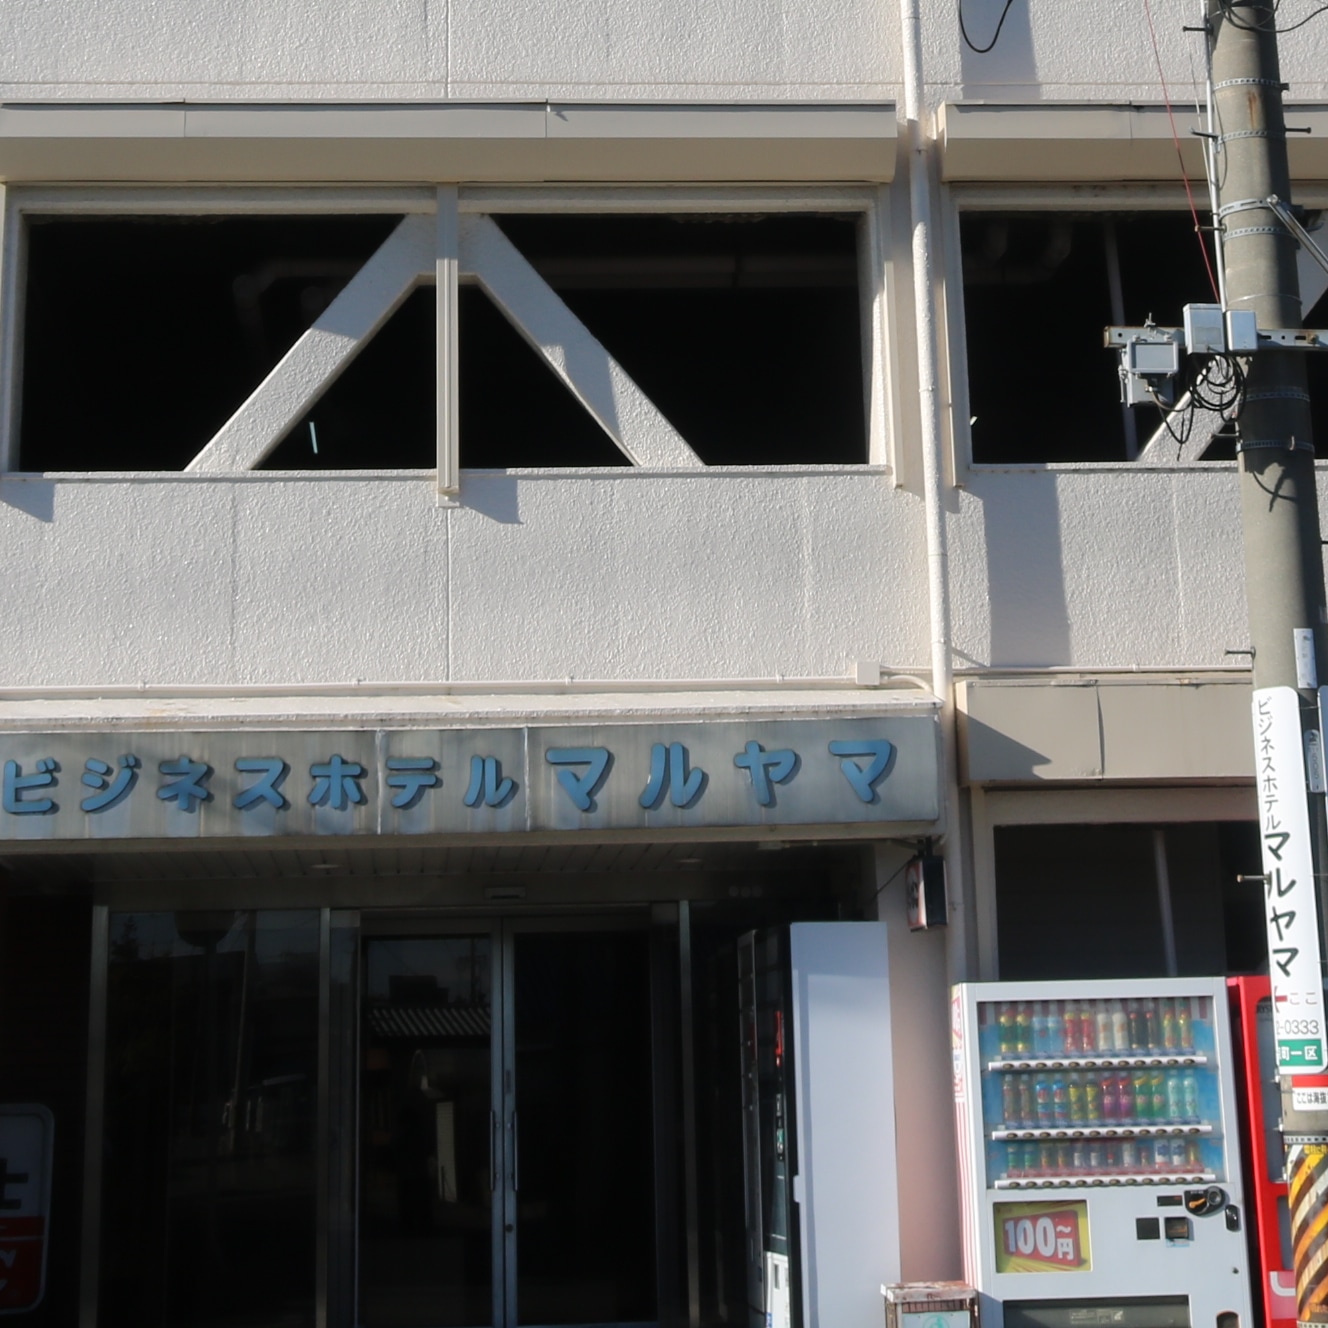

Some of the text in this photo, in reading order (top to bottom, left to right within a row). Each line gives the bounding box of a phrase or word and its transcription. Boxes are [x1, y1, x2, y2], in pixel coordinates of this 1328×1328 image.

[2, 739, 897, 814] ビジネスホテルマルヤマ
[1005, 1216, 1056, 1257] 100
